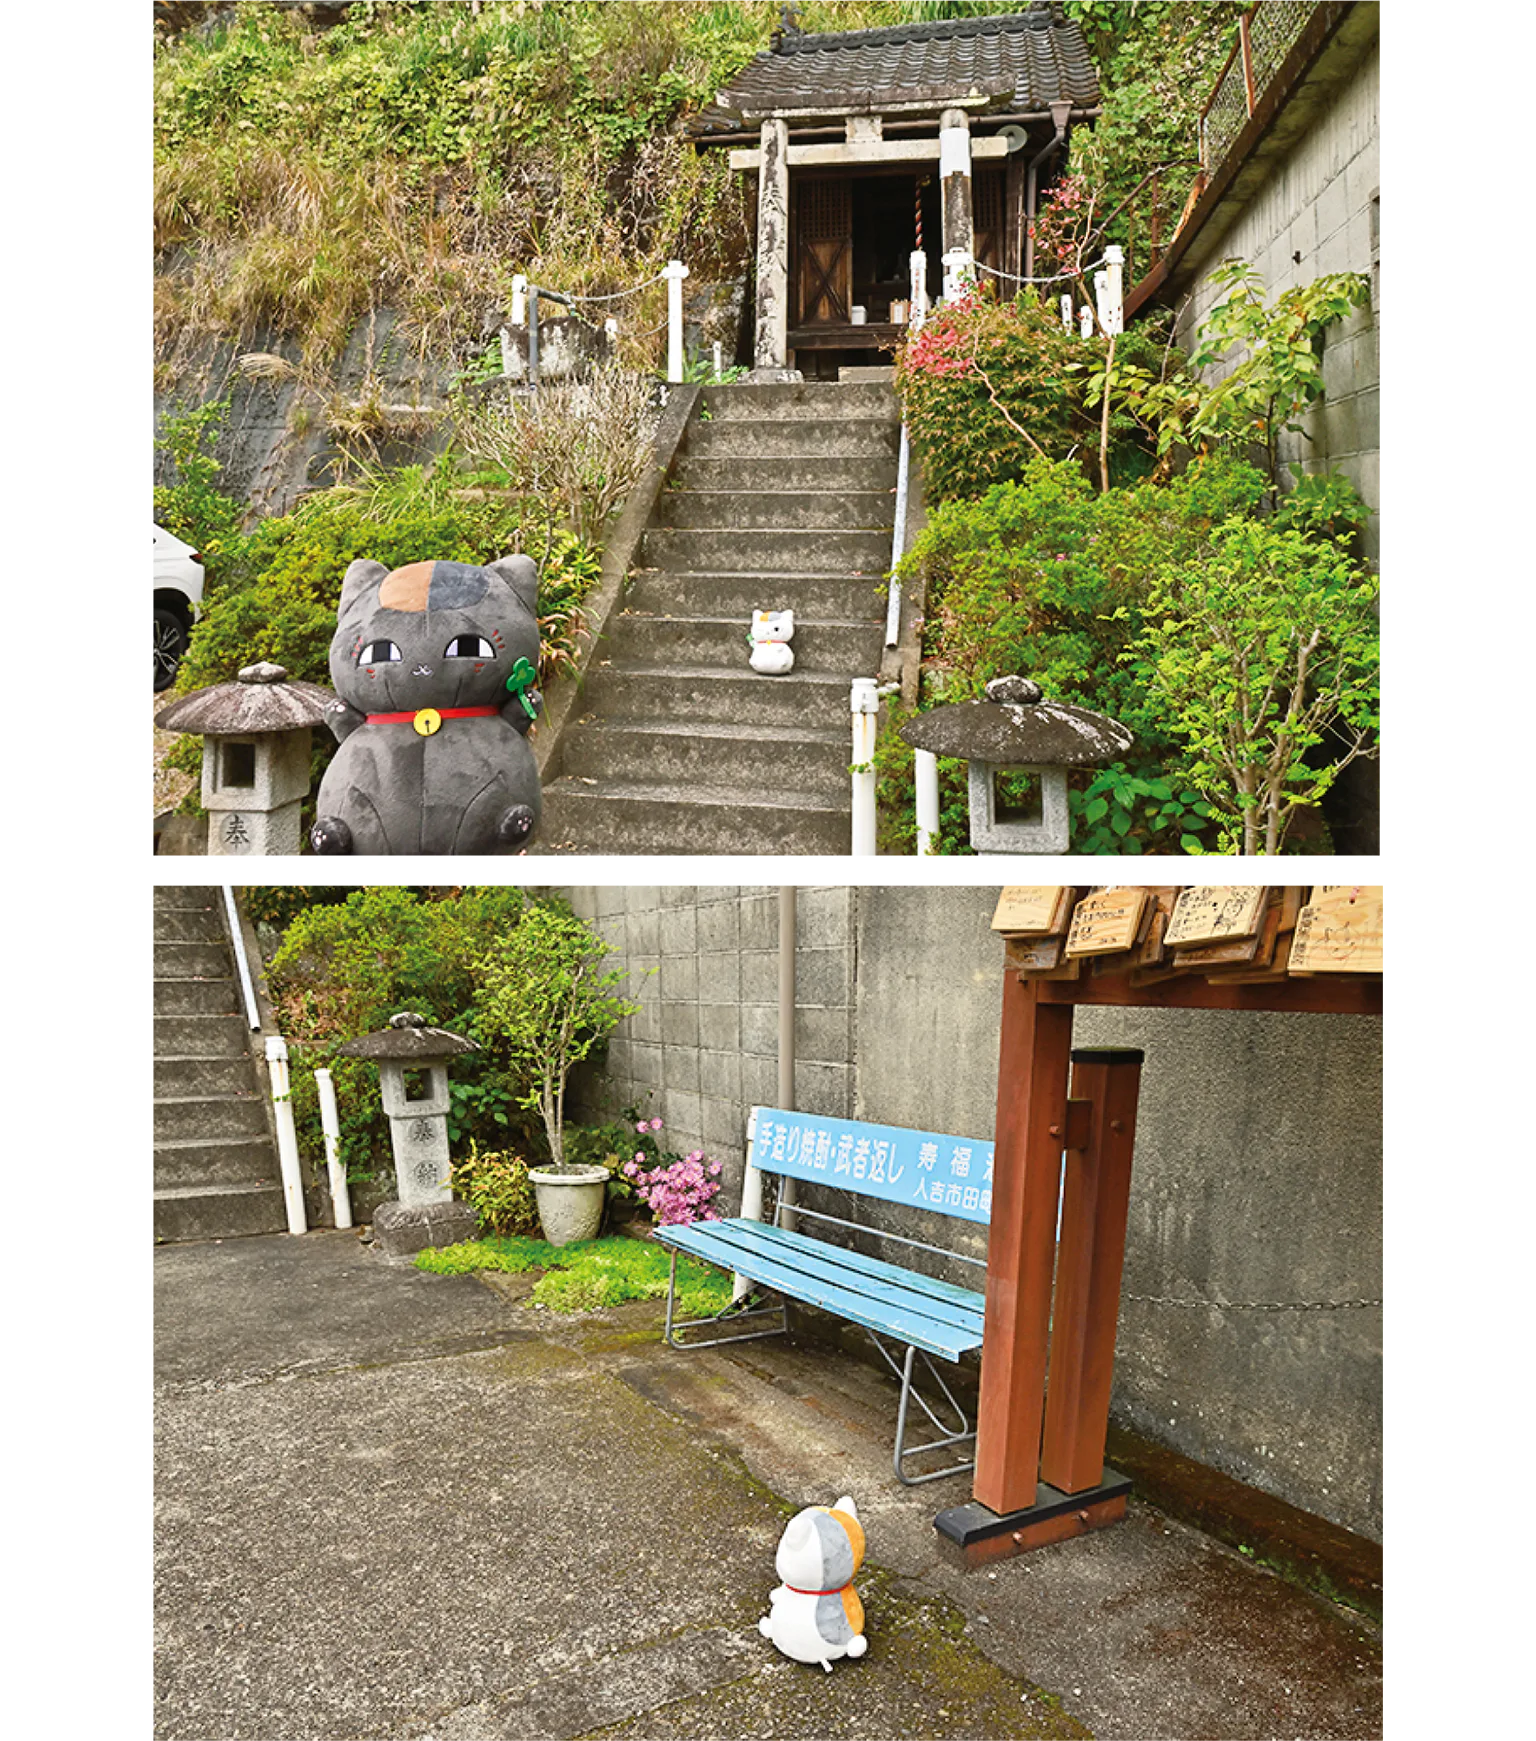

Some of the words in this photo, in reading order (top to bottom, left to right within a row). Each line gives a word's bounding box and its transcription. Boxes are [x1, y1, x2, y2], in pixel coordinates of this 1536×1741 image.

[224, 813, 250, 853] 奉
[759, 1121, 905, 1185] 手造り焼酎・武者返し
